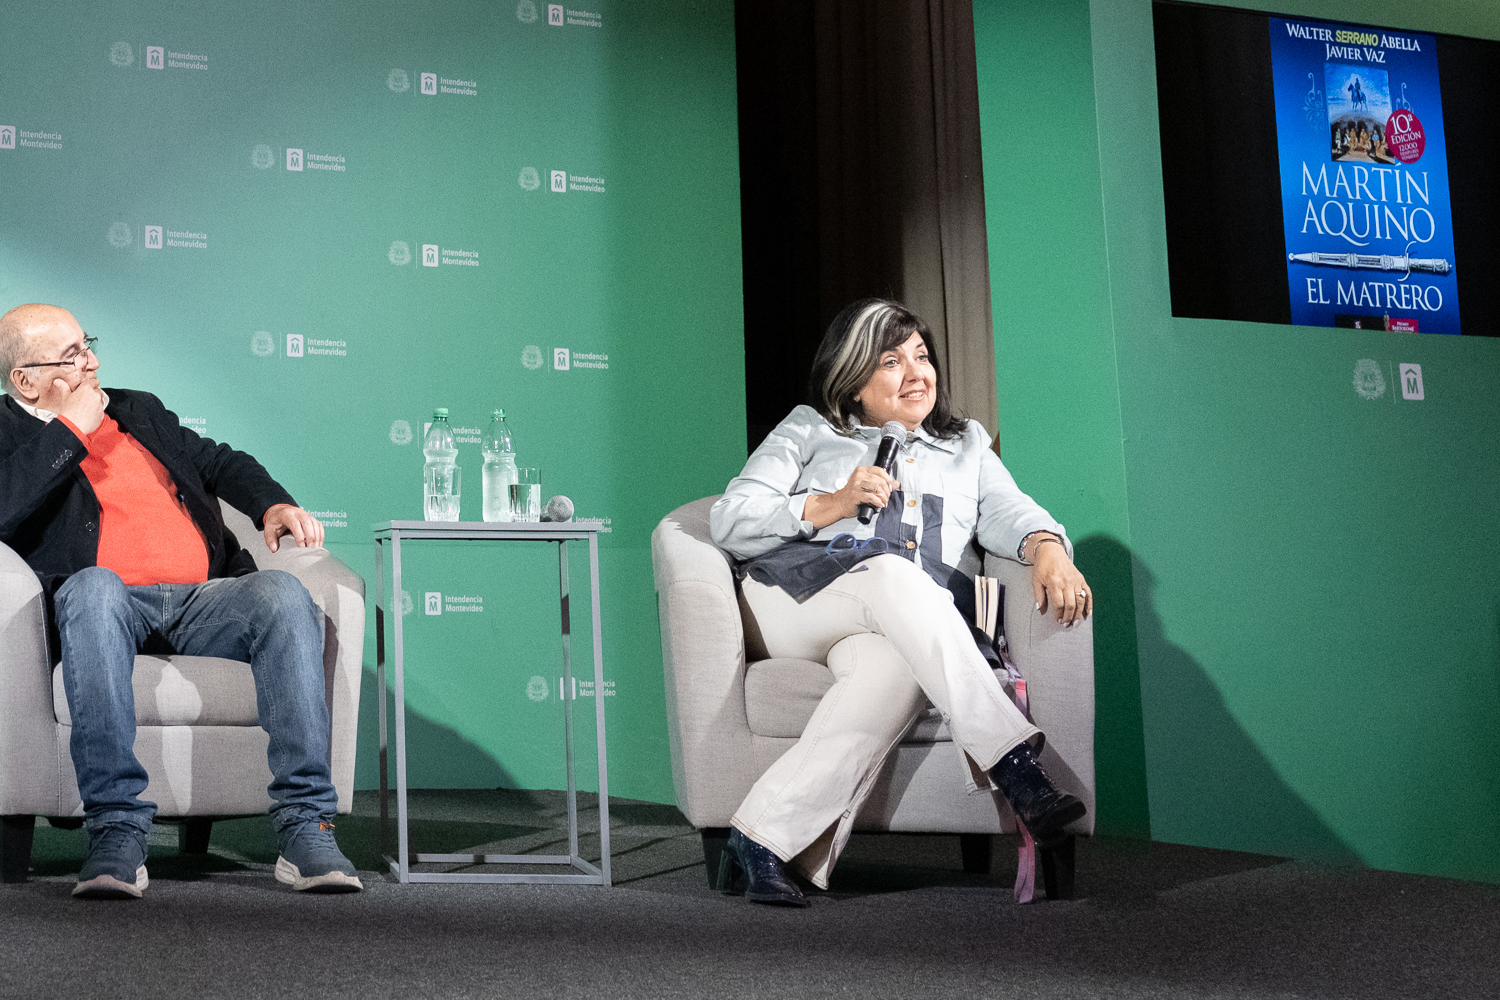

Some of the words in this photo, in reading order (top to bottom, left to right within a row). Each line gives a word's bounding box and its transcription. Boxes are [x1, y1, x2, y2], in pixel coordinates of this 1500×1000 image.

[567, 10, 601, 19] Intendencia
[567, 17, 602, 28] Montevideo
[1286, 23, 1334, 42] WALTER
[1335, 30, 1378, 46] SERRANO
[1380, 35, 1421, 52] ABELLA
[168, 51, 208, 62] Intendencia
[1325, 44, 1362, 61] JAVIER
[1363, 48, 1385, 63] VAZ
[168, 60, 208, 70] Montevideo
[440, 77, 477, 87] Intendencia
[440, 85, 477, 96] Montevideo
[20, 130, 62, 140] Intendencia
[1391, 131, 1422, 145] EDICIÓN
[20, 139, 62, 149] Montevideo
[307, 153, 345, 163] Intendencia
[307, 162, 346, 172] Montevideo
[570, 175, 605, 184] Intendencia
[1301, 161, 1429, 206] MARTÍN
[570, 183, 605, 193] Montevideo
[1301, 199, 1435, 246] AQUINO
[167, 230, 207, 240] Intendencia
[167, 239, 207, 249] Montevideo
[442, 249, 479, 258] Intendencia
[442, 257, 479, 266] Montevideo
[1306, 278, 1330, 304] EL
[1336, 280, 1443, 312] MATRERO
[308, 338, 346, 347] Intendencia
[308, 347, 347, 356] Montevideo
[573, 352, 608, 361] Intendencia
[573, 361, 609, 369] Montevideo
[445, 595, 483, 603] Intendencia
[446, 604, 483, 612] Montevideo
